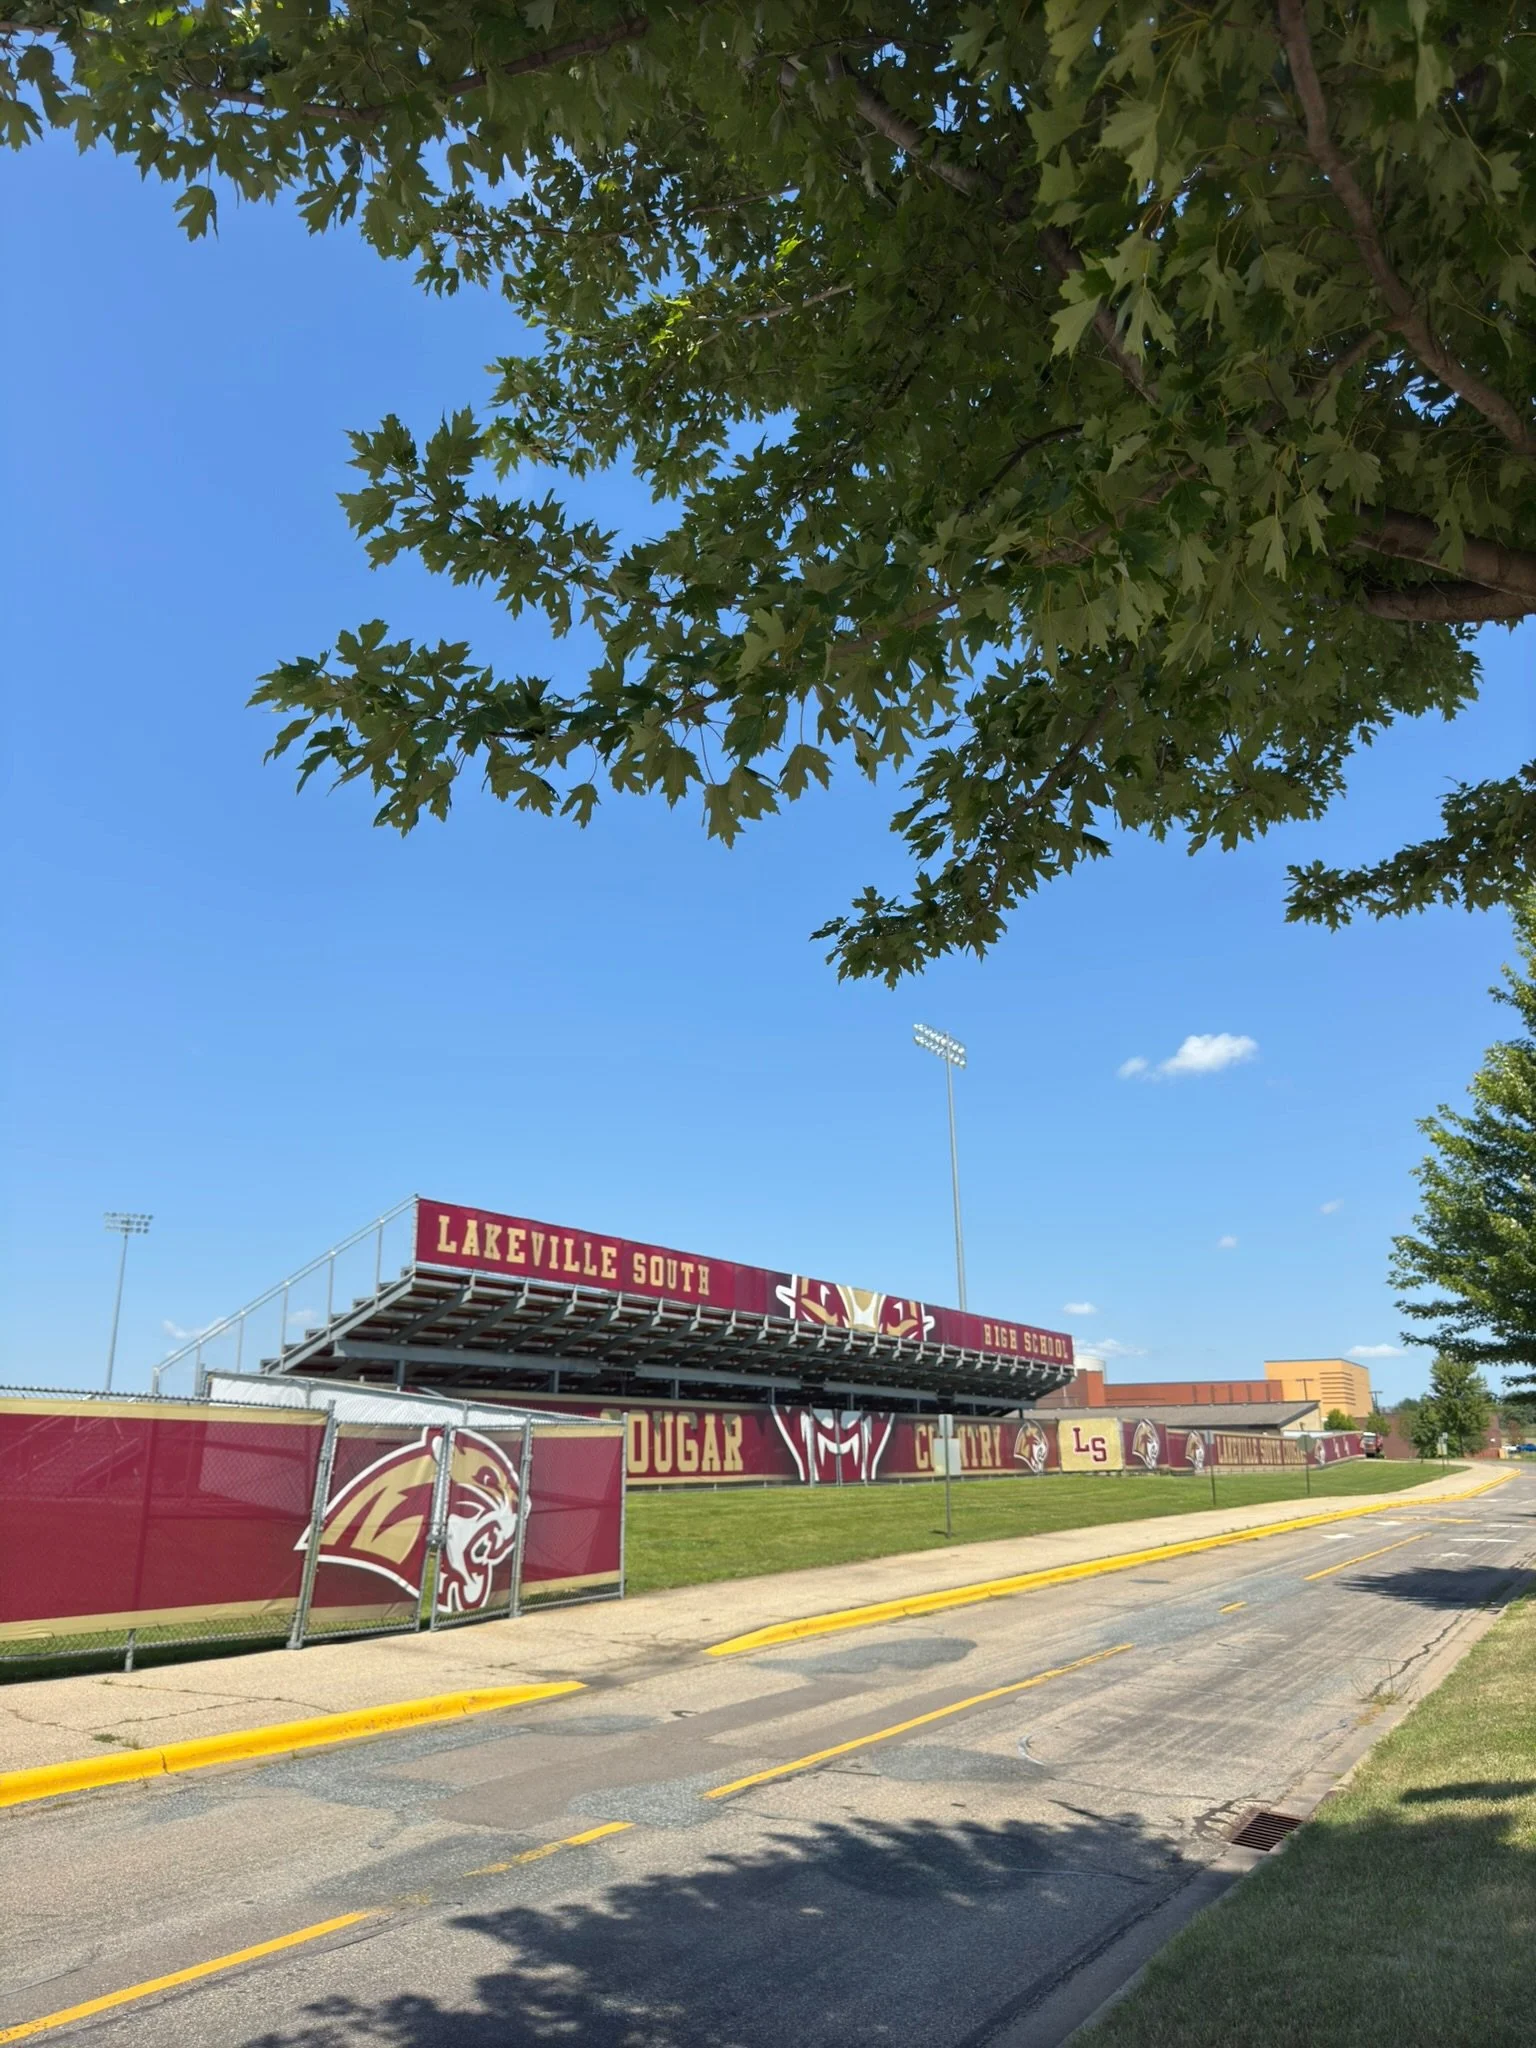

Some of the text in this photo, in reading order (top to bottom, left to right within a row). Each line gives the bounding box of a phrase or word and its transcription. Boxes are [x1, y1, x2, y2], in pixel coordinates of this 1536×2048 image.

[437, 1214, 1069, 1360] LAKEVILLE SOUTH HIGH SCHOOL
[600, 1408, 744, 1473] OUGAR
